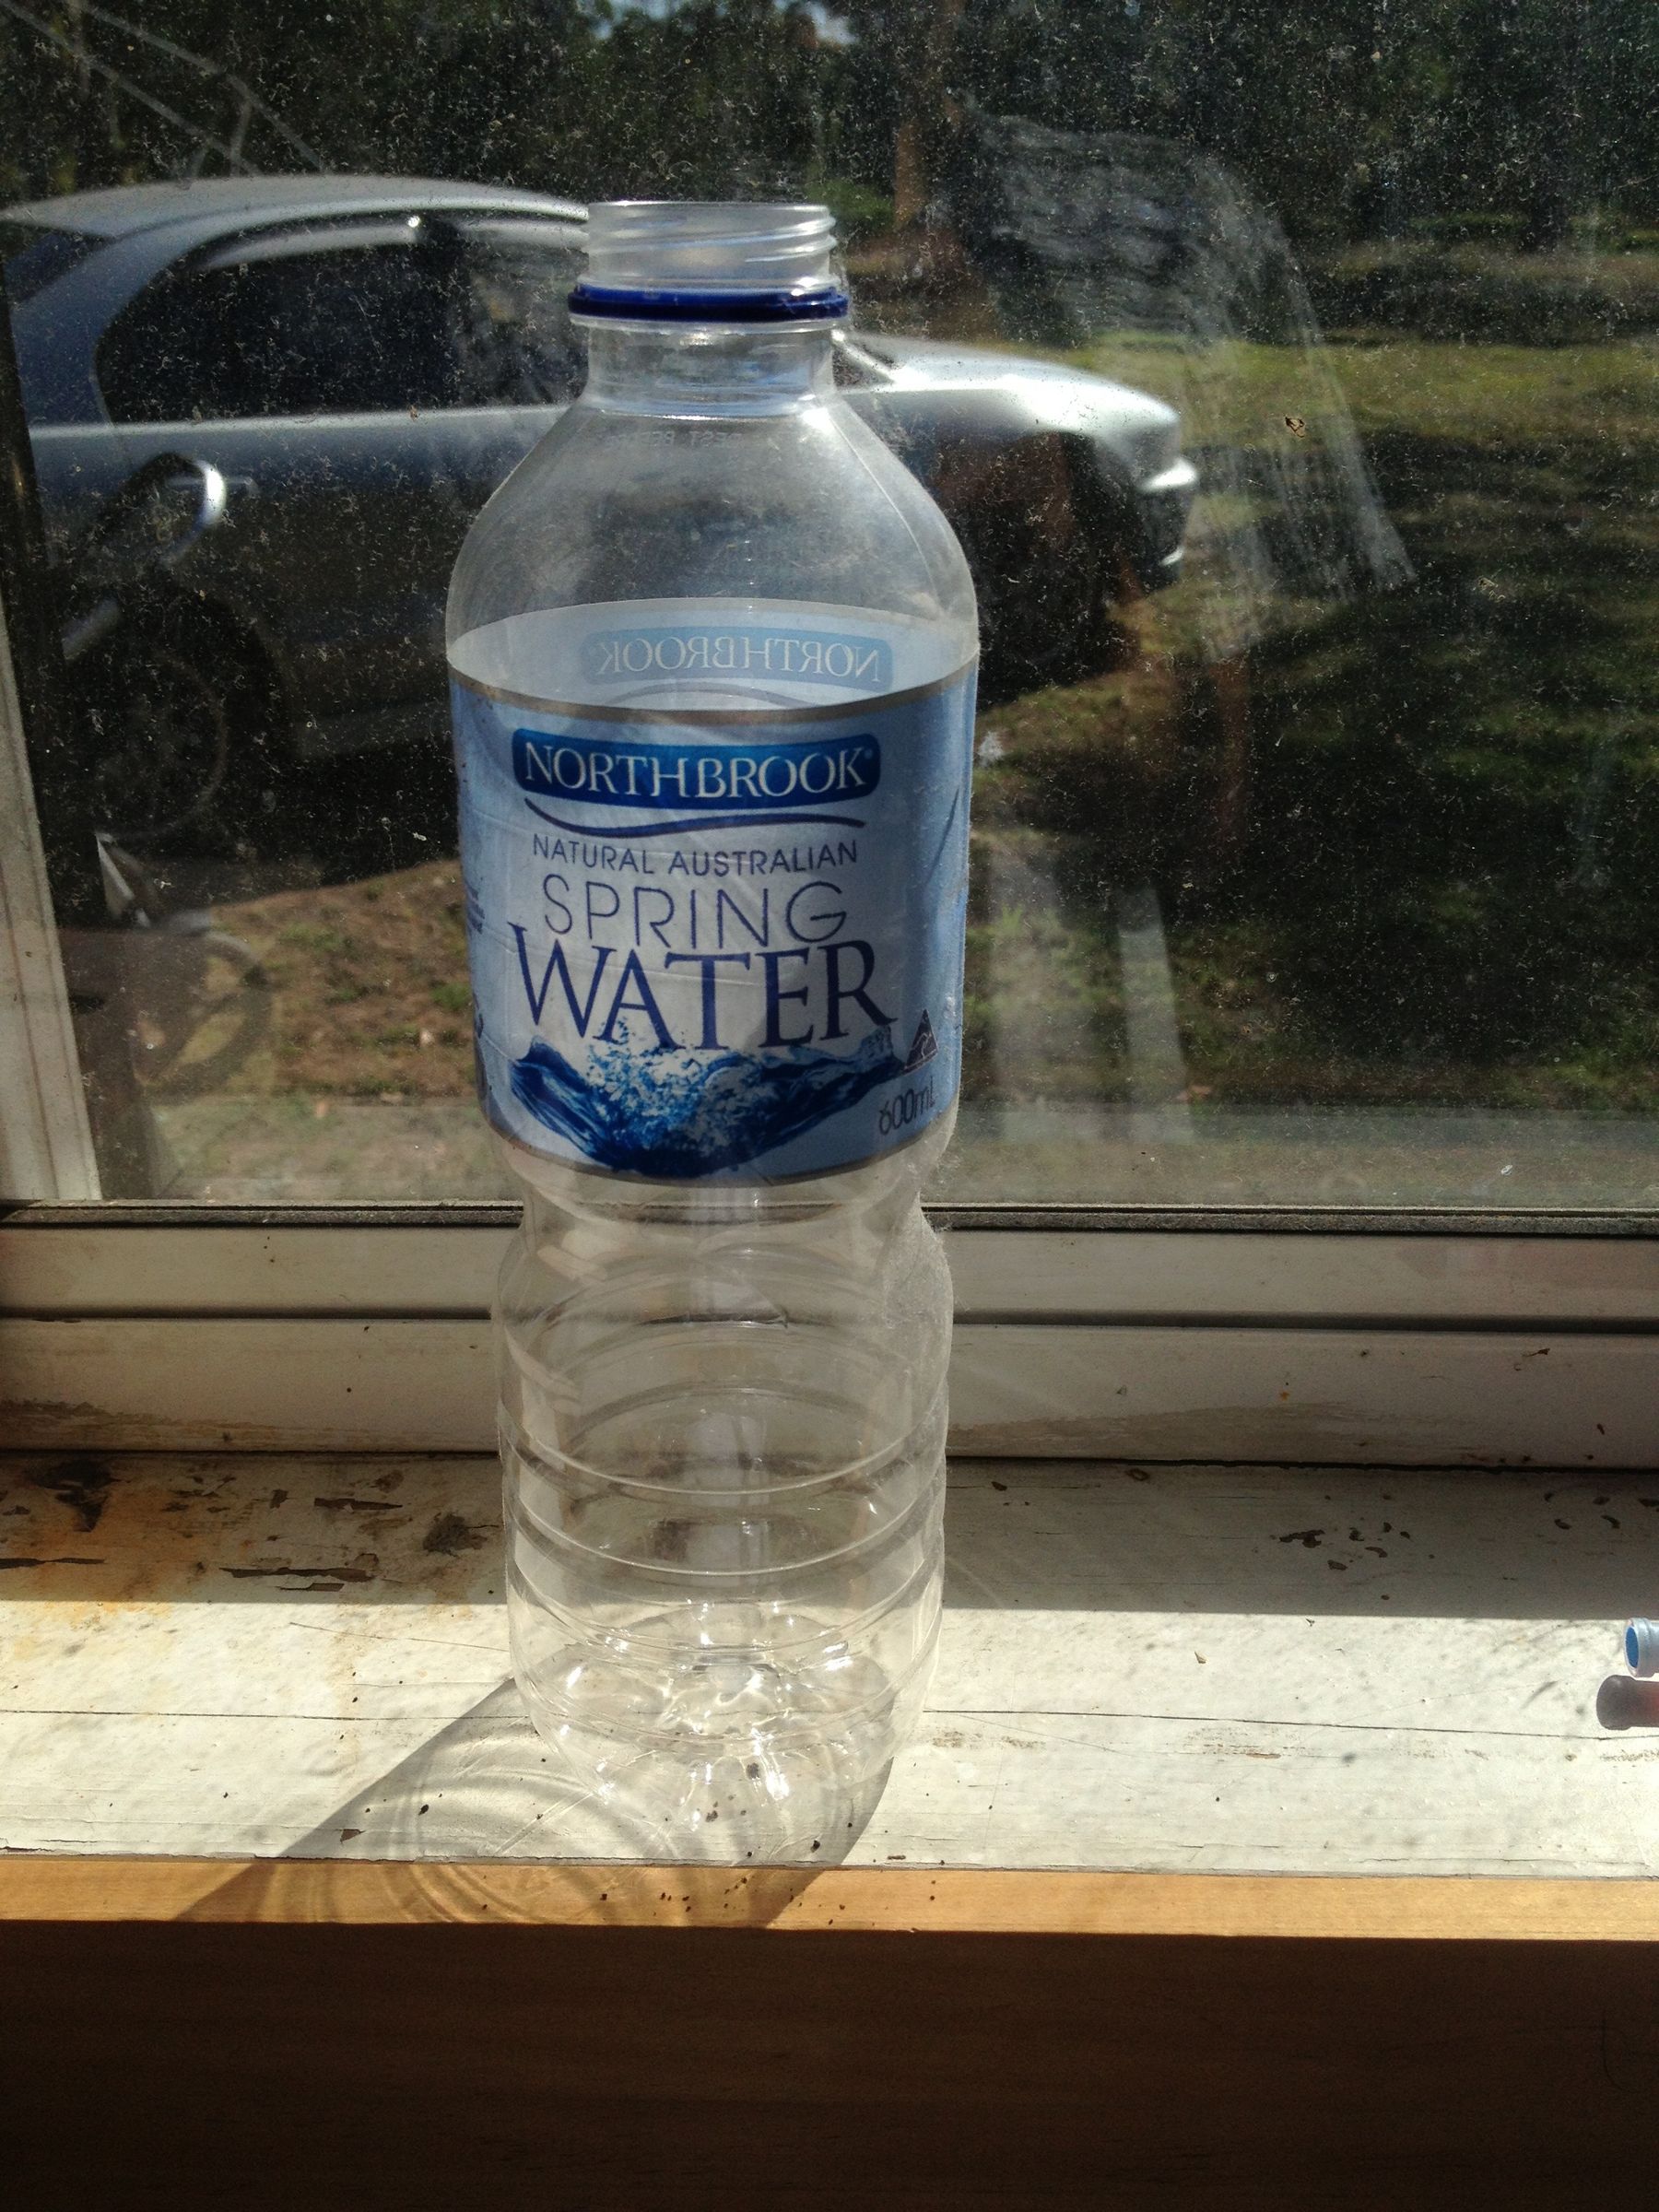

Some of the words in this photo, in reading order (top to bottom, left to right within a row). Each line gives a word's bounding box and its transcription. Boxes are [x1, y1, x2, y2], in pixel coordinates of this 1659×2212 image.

[524, 741, 868, 798] NORTHBROOK
[533, 833, 653, 874] NATURAL
[667, 839, 858, 877] AUSTRALIAN
[542, 874, 848, 949] SPRING
[506, 921, 899, 1051] WATER
